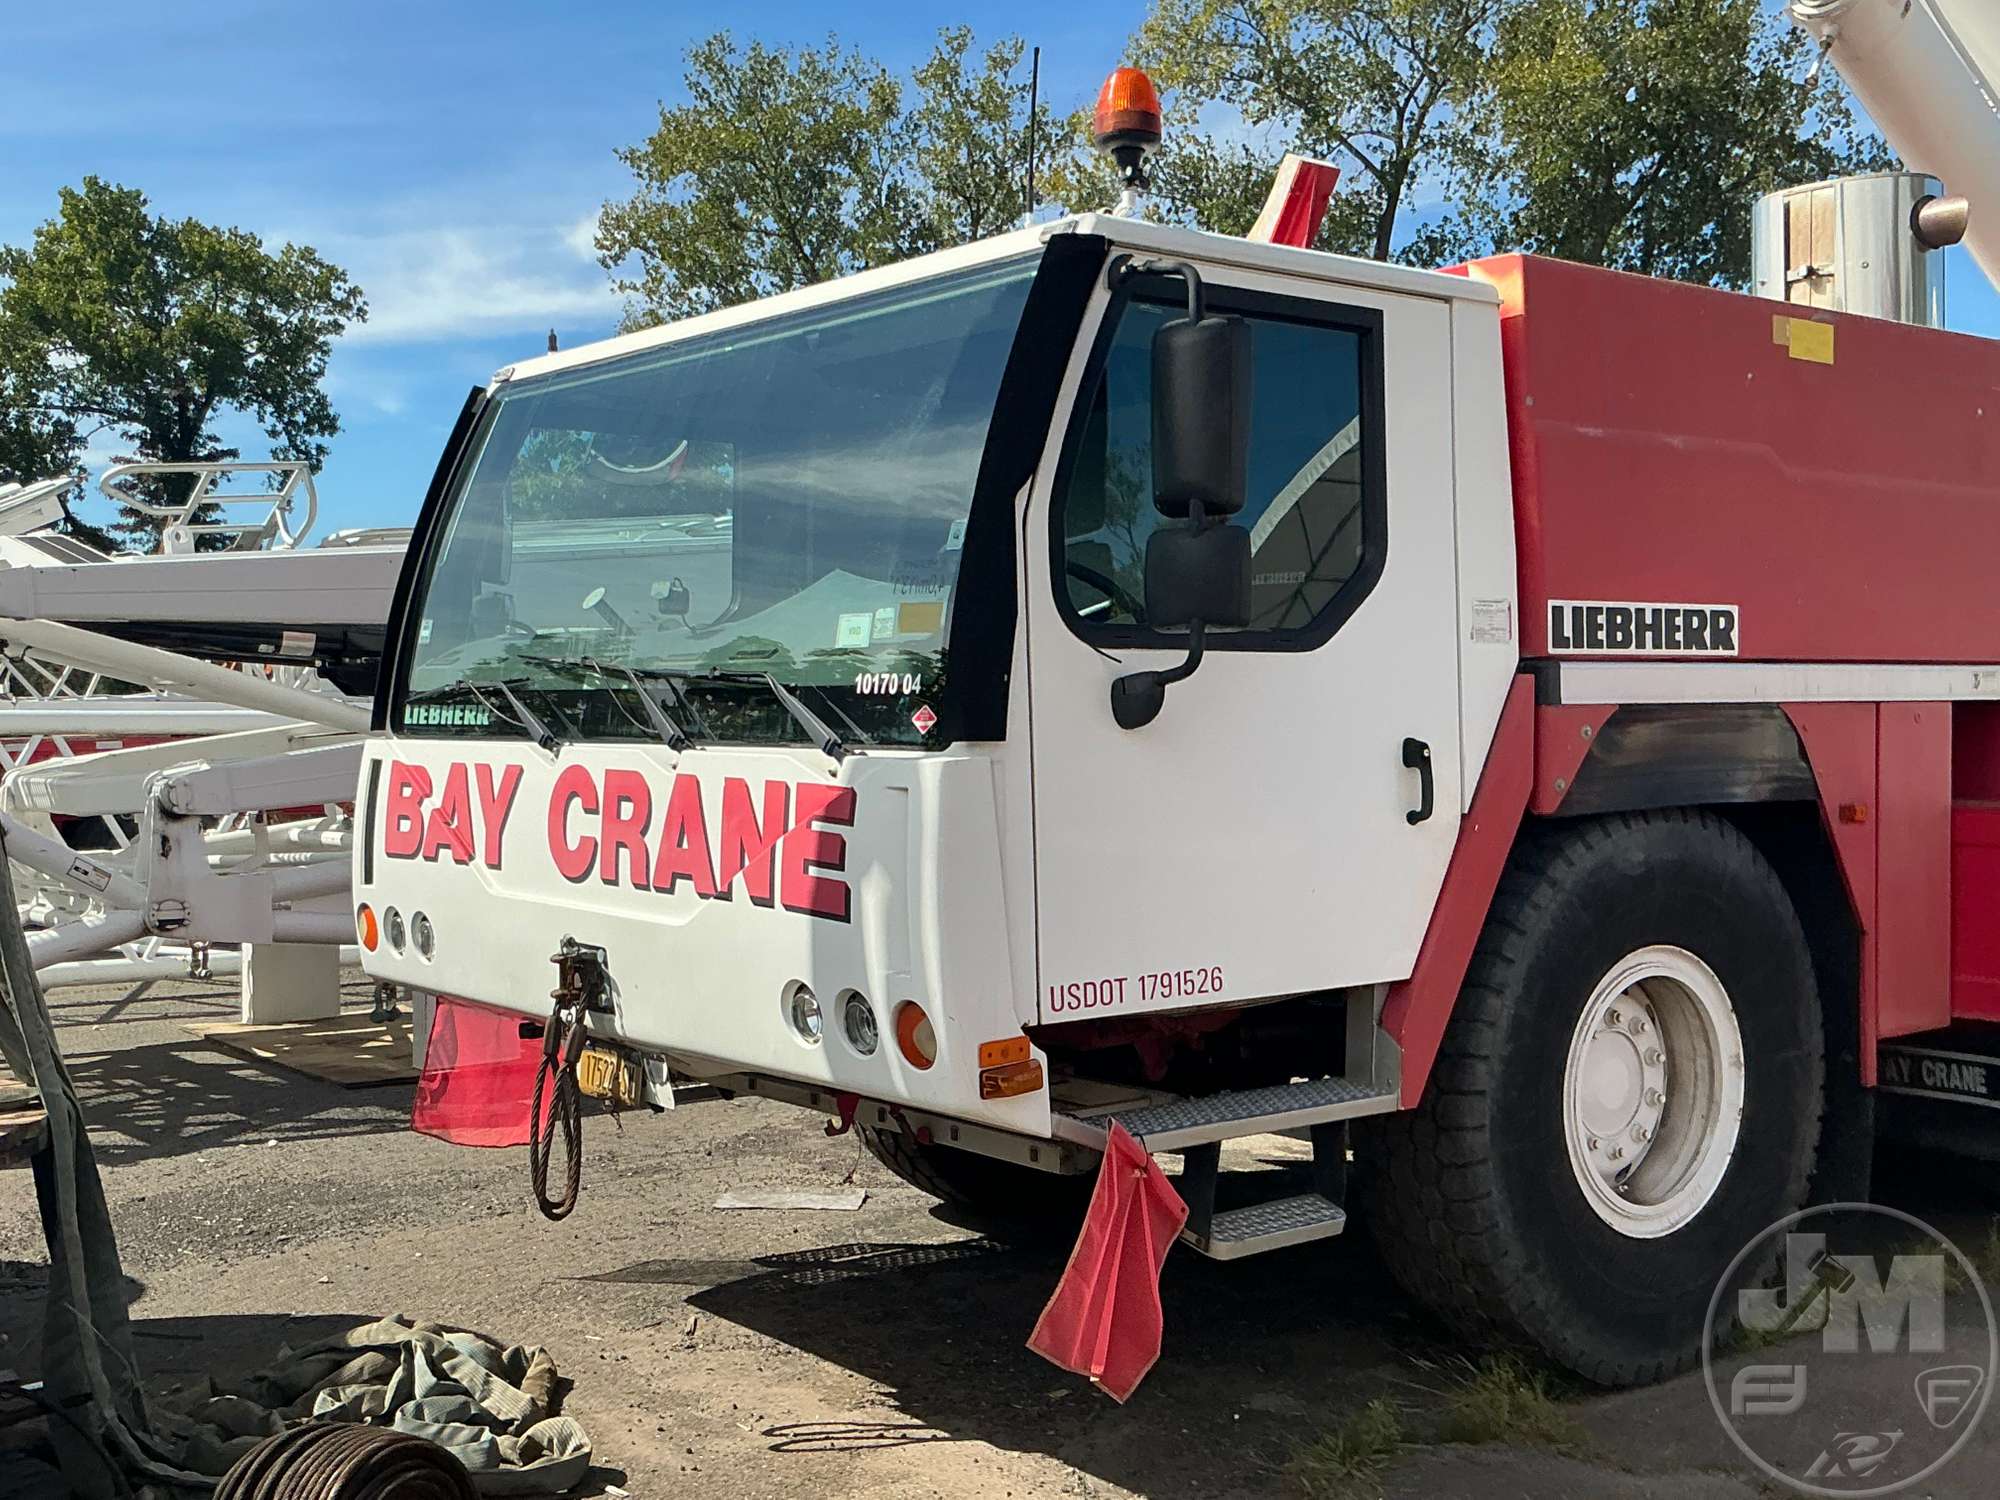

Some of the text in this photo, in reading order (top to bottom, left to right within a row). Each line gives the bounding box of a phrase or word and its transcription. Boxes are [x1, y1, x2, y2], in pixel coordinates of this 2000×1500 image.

[1551, 605, 1736, 650] LIEBHERR
[855, 673, 922, 695] 10170 04
[404, 704, 490, 726] LIEBHERR
[385, 759, 857, 924] BAY CRANE
[1050, 966, 1223, 1013] USDOT 1791526
[1880, 1056, 1987, 1094] AY CRANE
